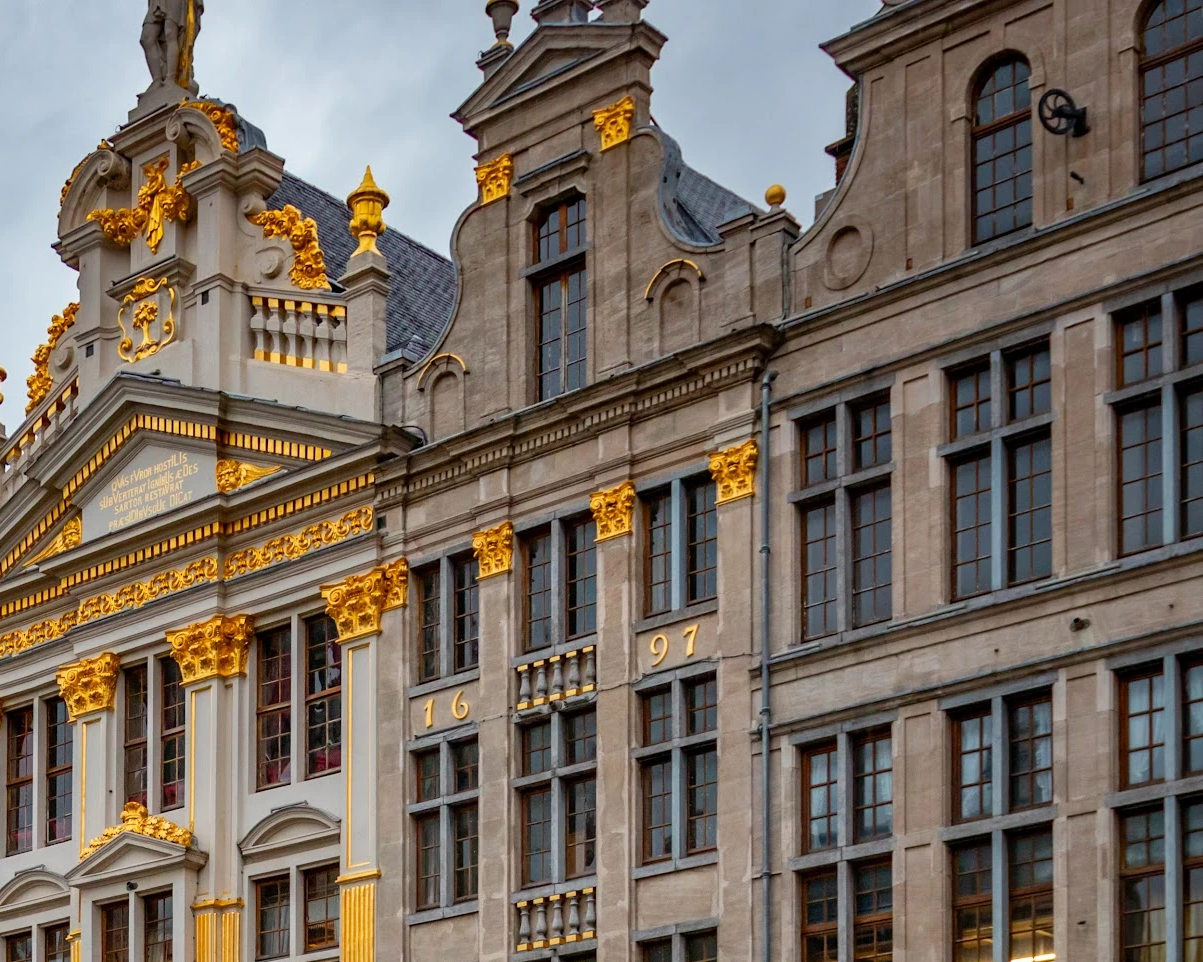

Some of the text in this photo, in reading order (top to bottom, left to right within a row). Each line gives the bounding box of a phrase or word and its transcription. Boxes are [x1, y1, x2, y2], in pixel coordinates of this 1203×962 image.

[153, 451, 188, 475] HOSTILIS
[113, 496, 143, 515] SARTOR
[169, 490, 193, 508] DICAT
[423, 623, 700, 729] 16 97
